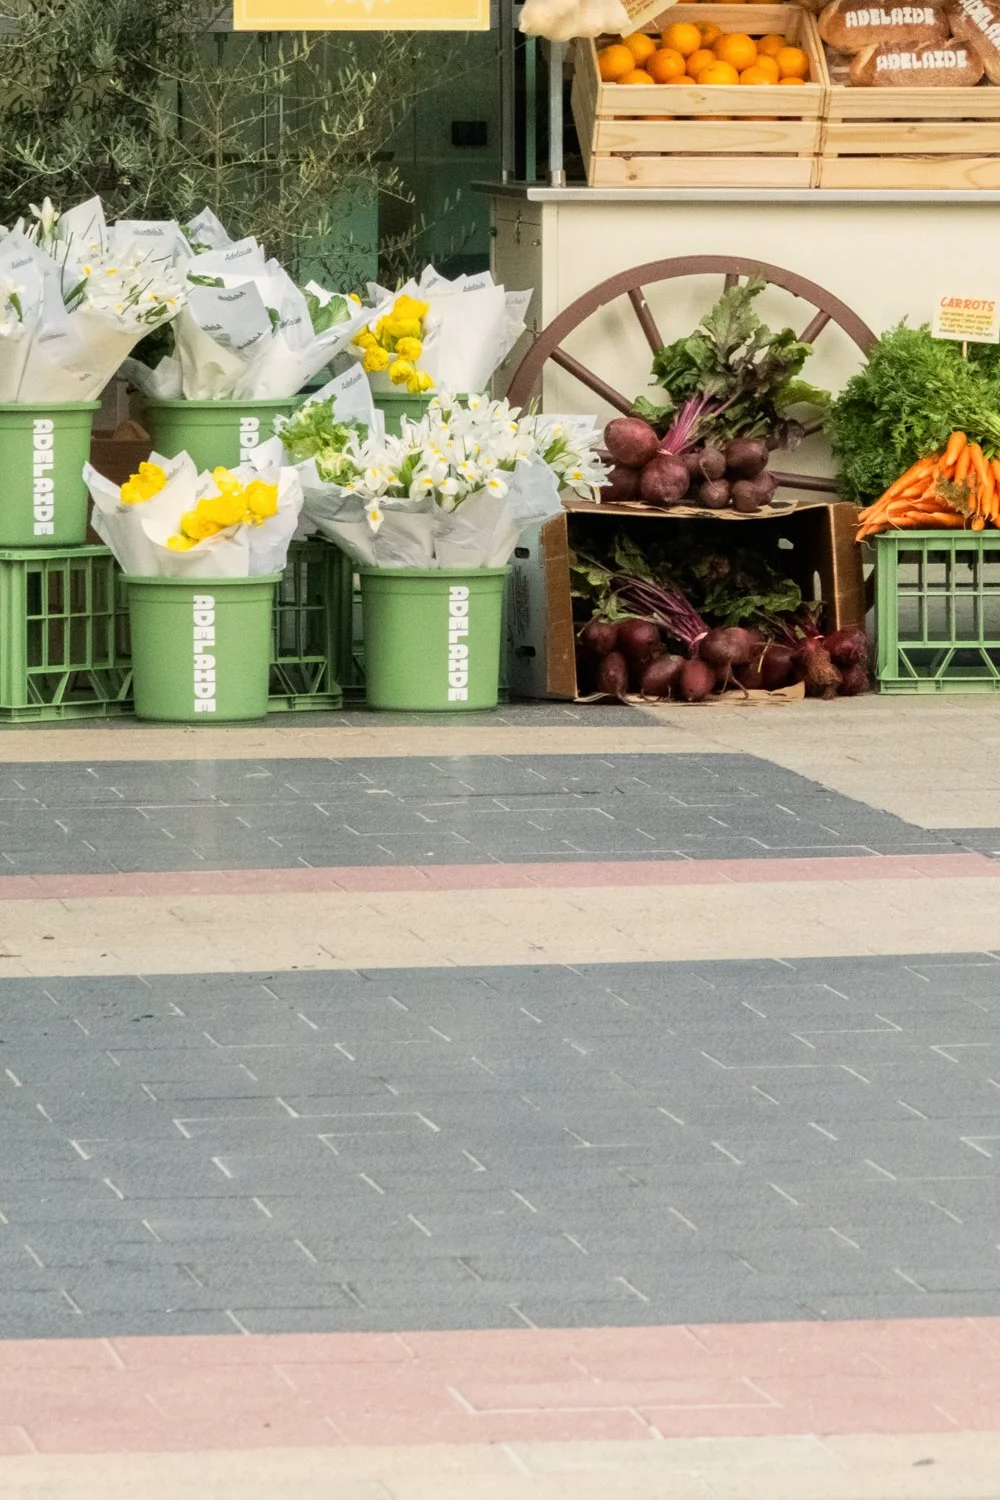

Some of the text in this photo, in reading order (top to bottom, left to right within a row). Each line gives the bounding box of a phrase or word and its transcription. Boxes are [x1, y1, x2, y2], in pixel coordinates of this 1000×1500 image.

[845, 7, 935, 28] ADELAIDE
[876, 50, 968, 72] ADELAIDE
[940, 296, 995, 312] CARROTS
[33, 419, 54, 536] ADELAIDE
[193, 595, 216, 712] ADELAIDE
[448, 586, 469, 701] ADELAIDE
